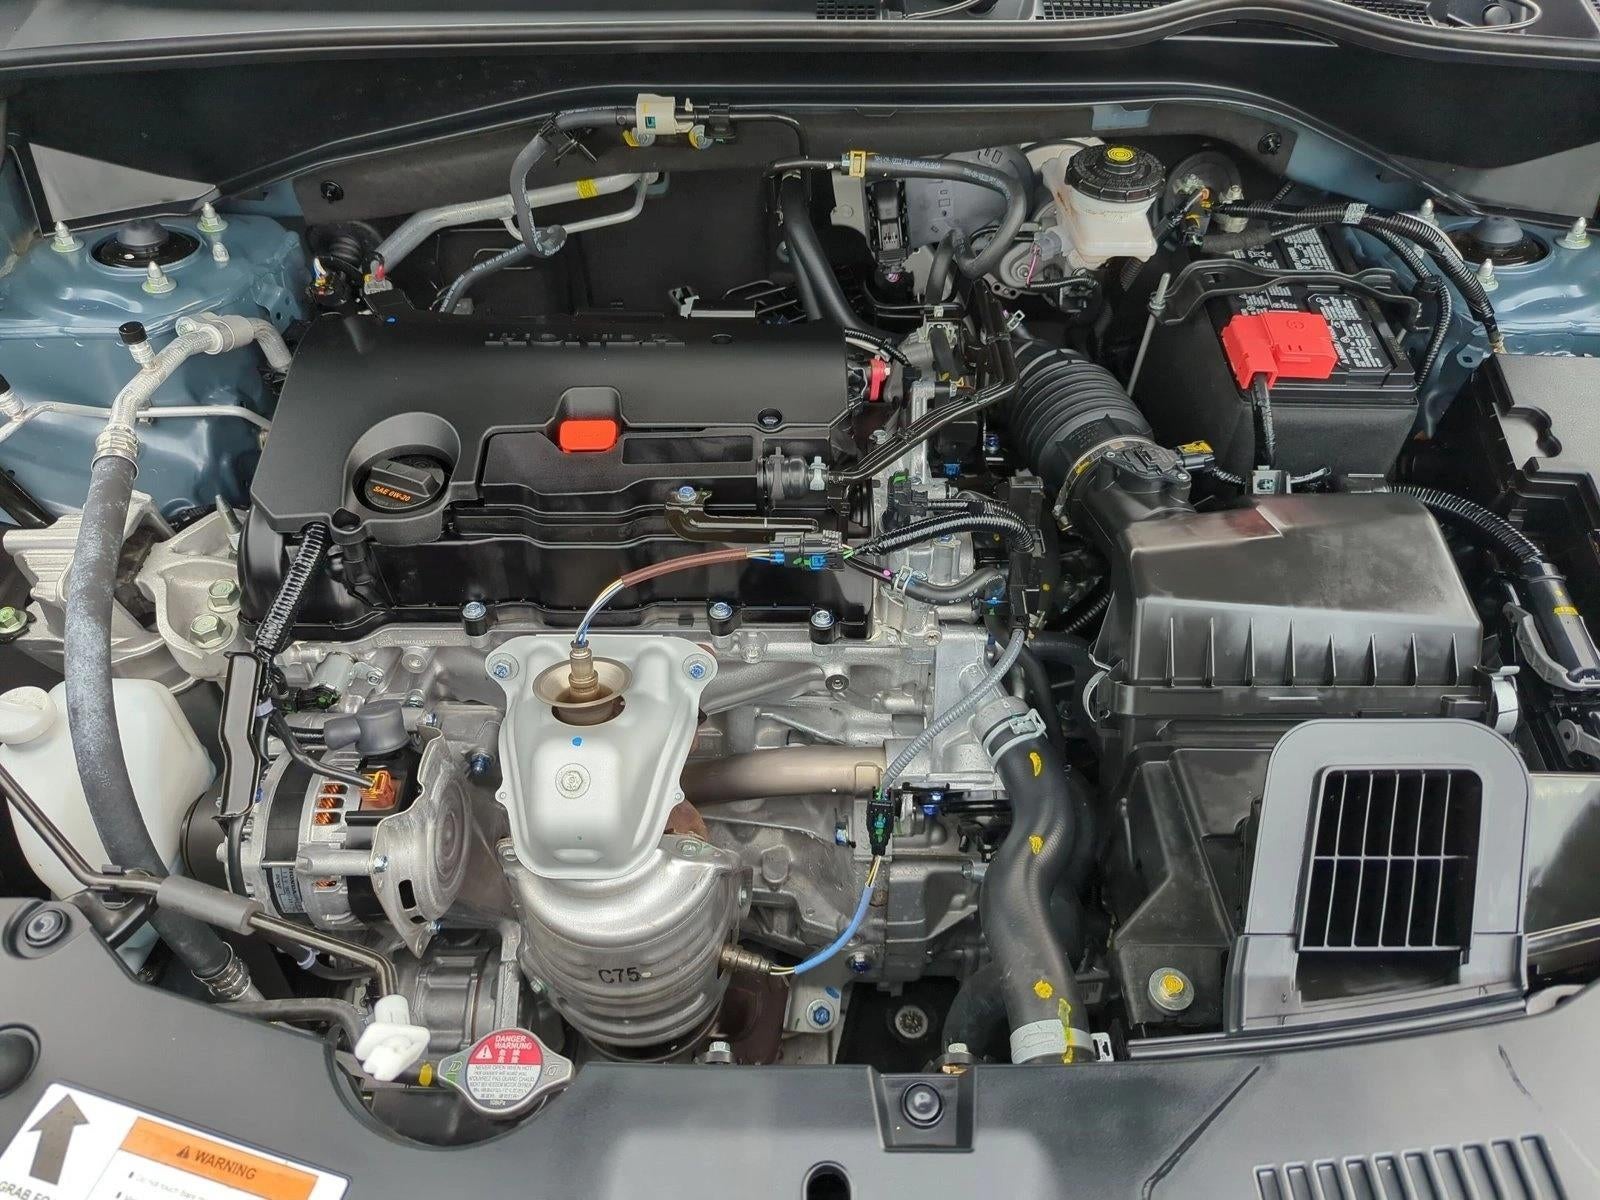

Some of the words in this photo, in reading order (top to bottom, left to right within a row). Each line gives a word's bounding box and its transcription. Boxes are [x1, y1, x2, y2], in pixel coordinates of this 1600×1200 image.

[372, 485, 389, 496] SAE
[388, 489, 411, 502] 0W-20
[598, 967, 641, 984] C75
[494, 1042, 532, 1050] WARNUNG
[495, 1035, 527, 1043] DANGER
[194, 1150, 257, 1180] WARNING
[0, 1180, 33, 1200] GRAB
